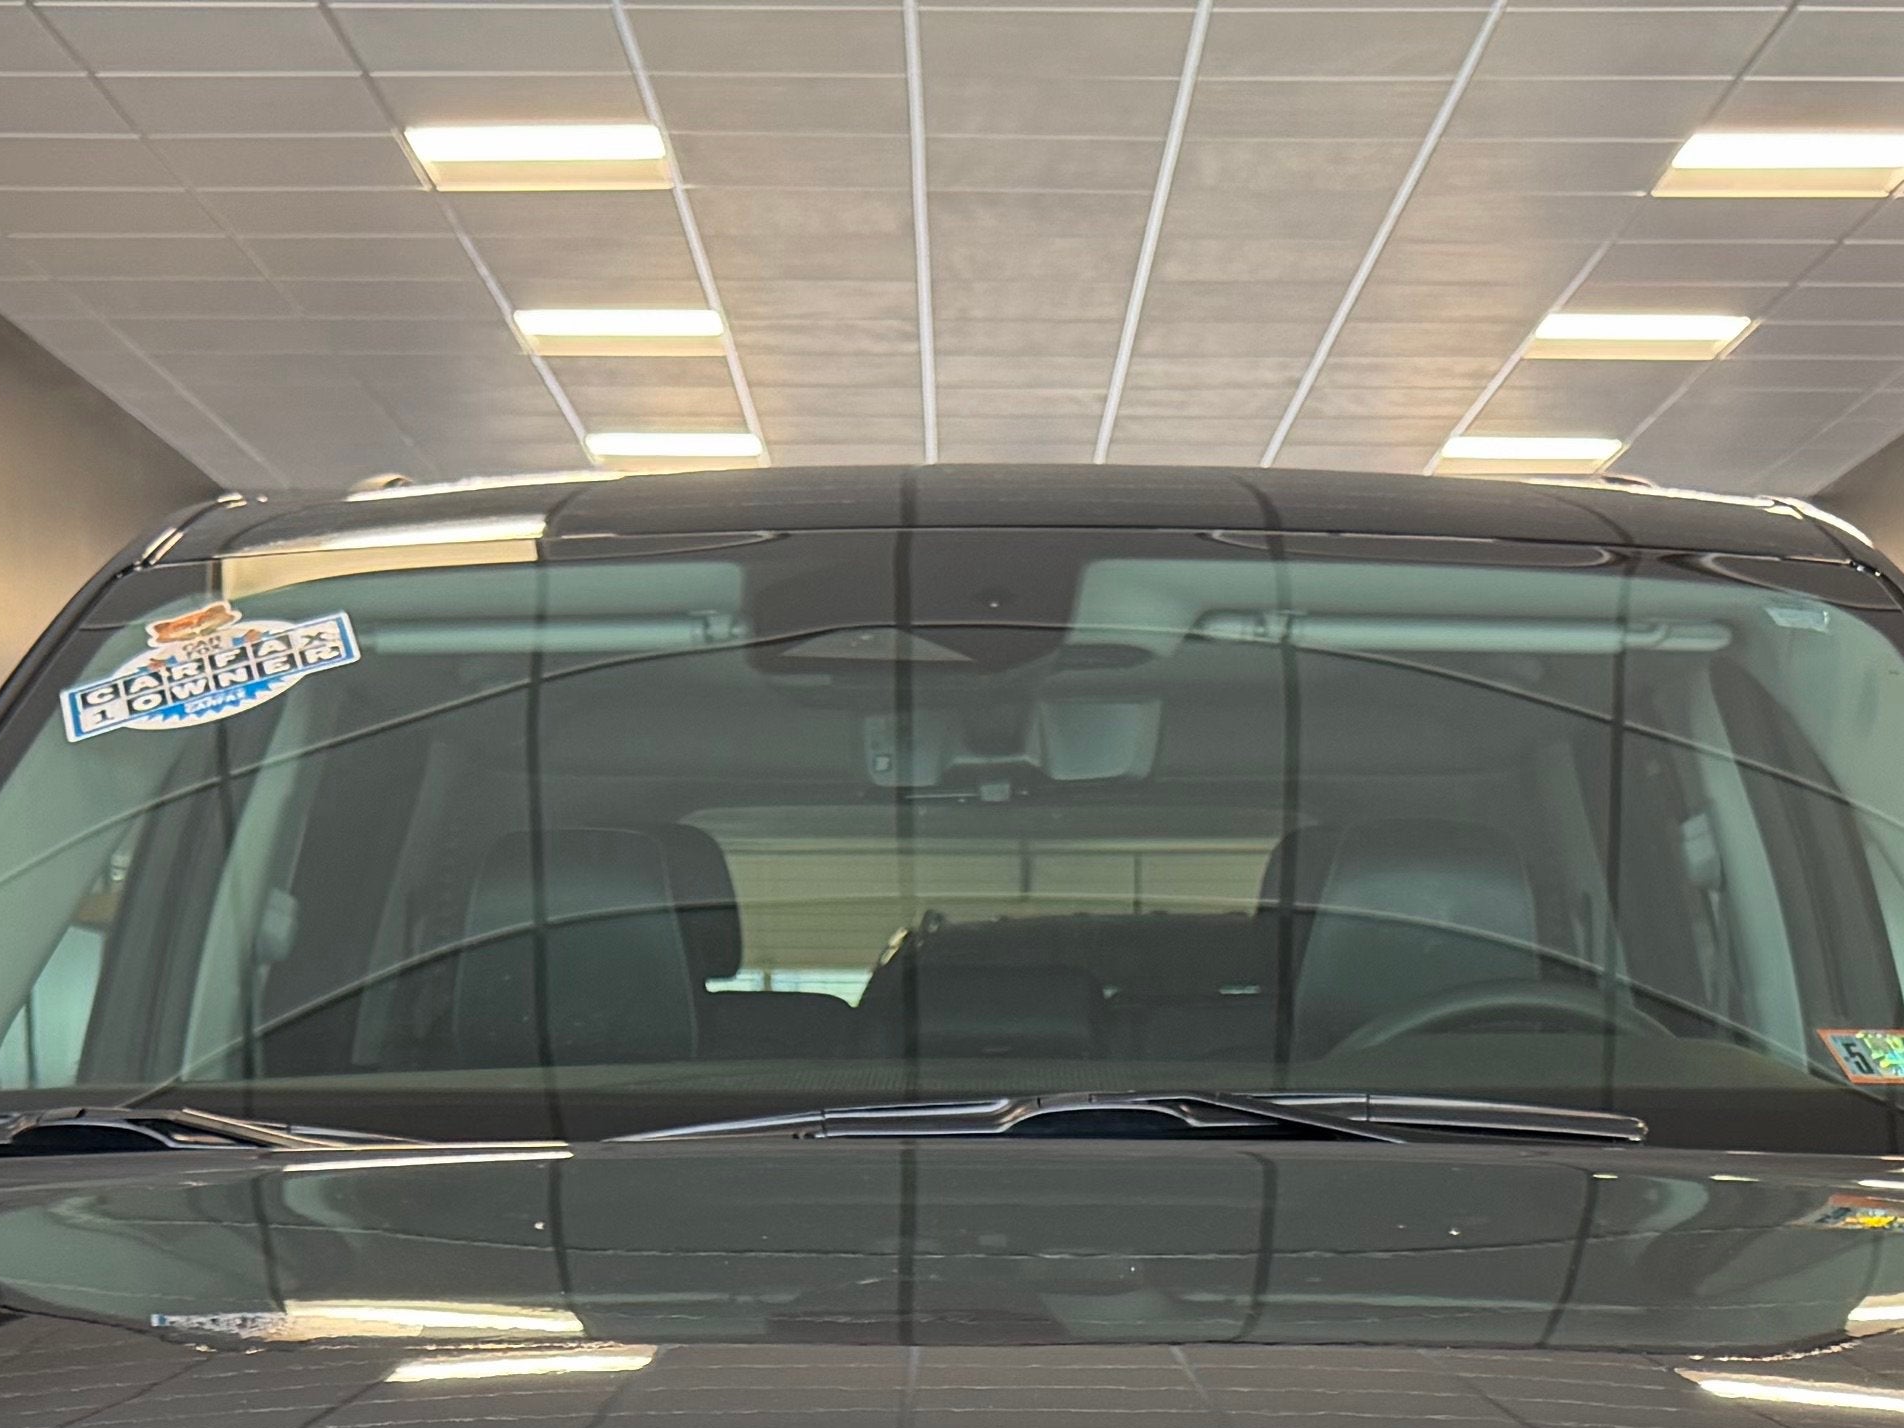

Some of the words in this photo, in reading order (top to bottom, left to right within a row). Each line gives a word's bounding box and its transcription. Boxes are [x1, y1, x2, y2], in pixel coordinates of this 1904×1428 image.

[85, 631, 330, 705] CARFAX
[94, 707, 116, 725] 1
[131, 645, 342, 712] OWNER
[1841, 1042, 1874, 1074] 5
